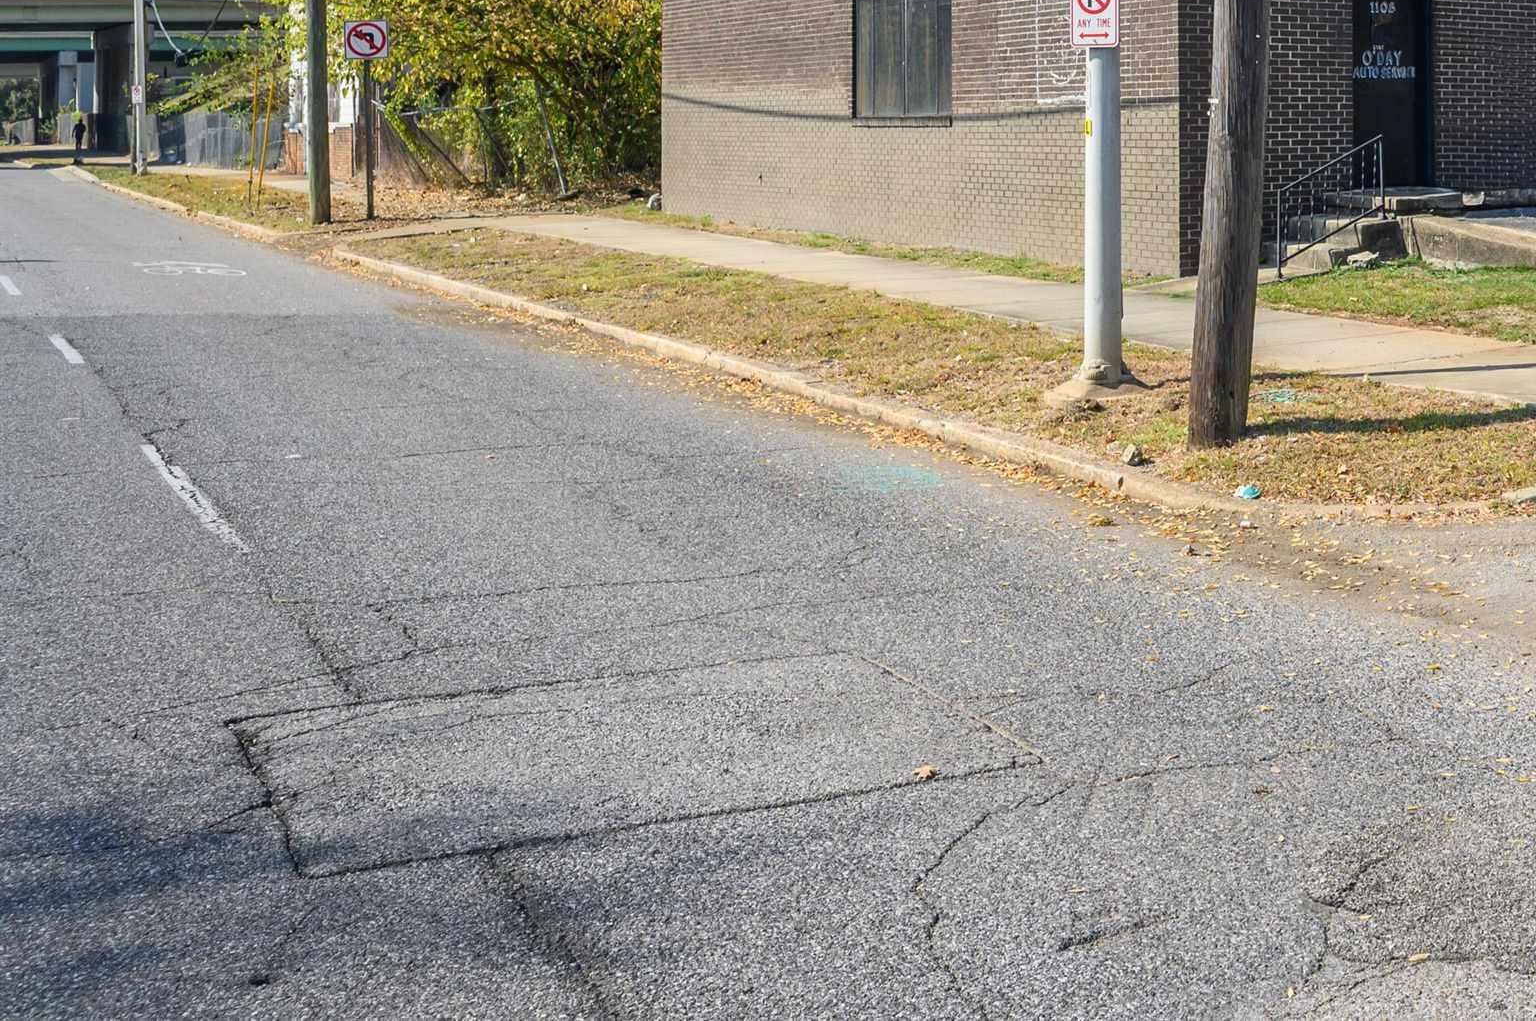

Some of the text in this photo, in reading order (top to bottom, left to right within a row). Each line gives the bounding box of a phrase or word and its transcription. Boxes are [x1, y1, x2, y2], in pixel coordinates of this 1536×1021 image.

[1077, 18, 1112, 28] ANY TIME
[1362, 49, 1402, 66] O'DAY
[1352, 66, 1379, 79] AUTO
